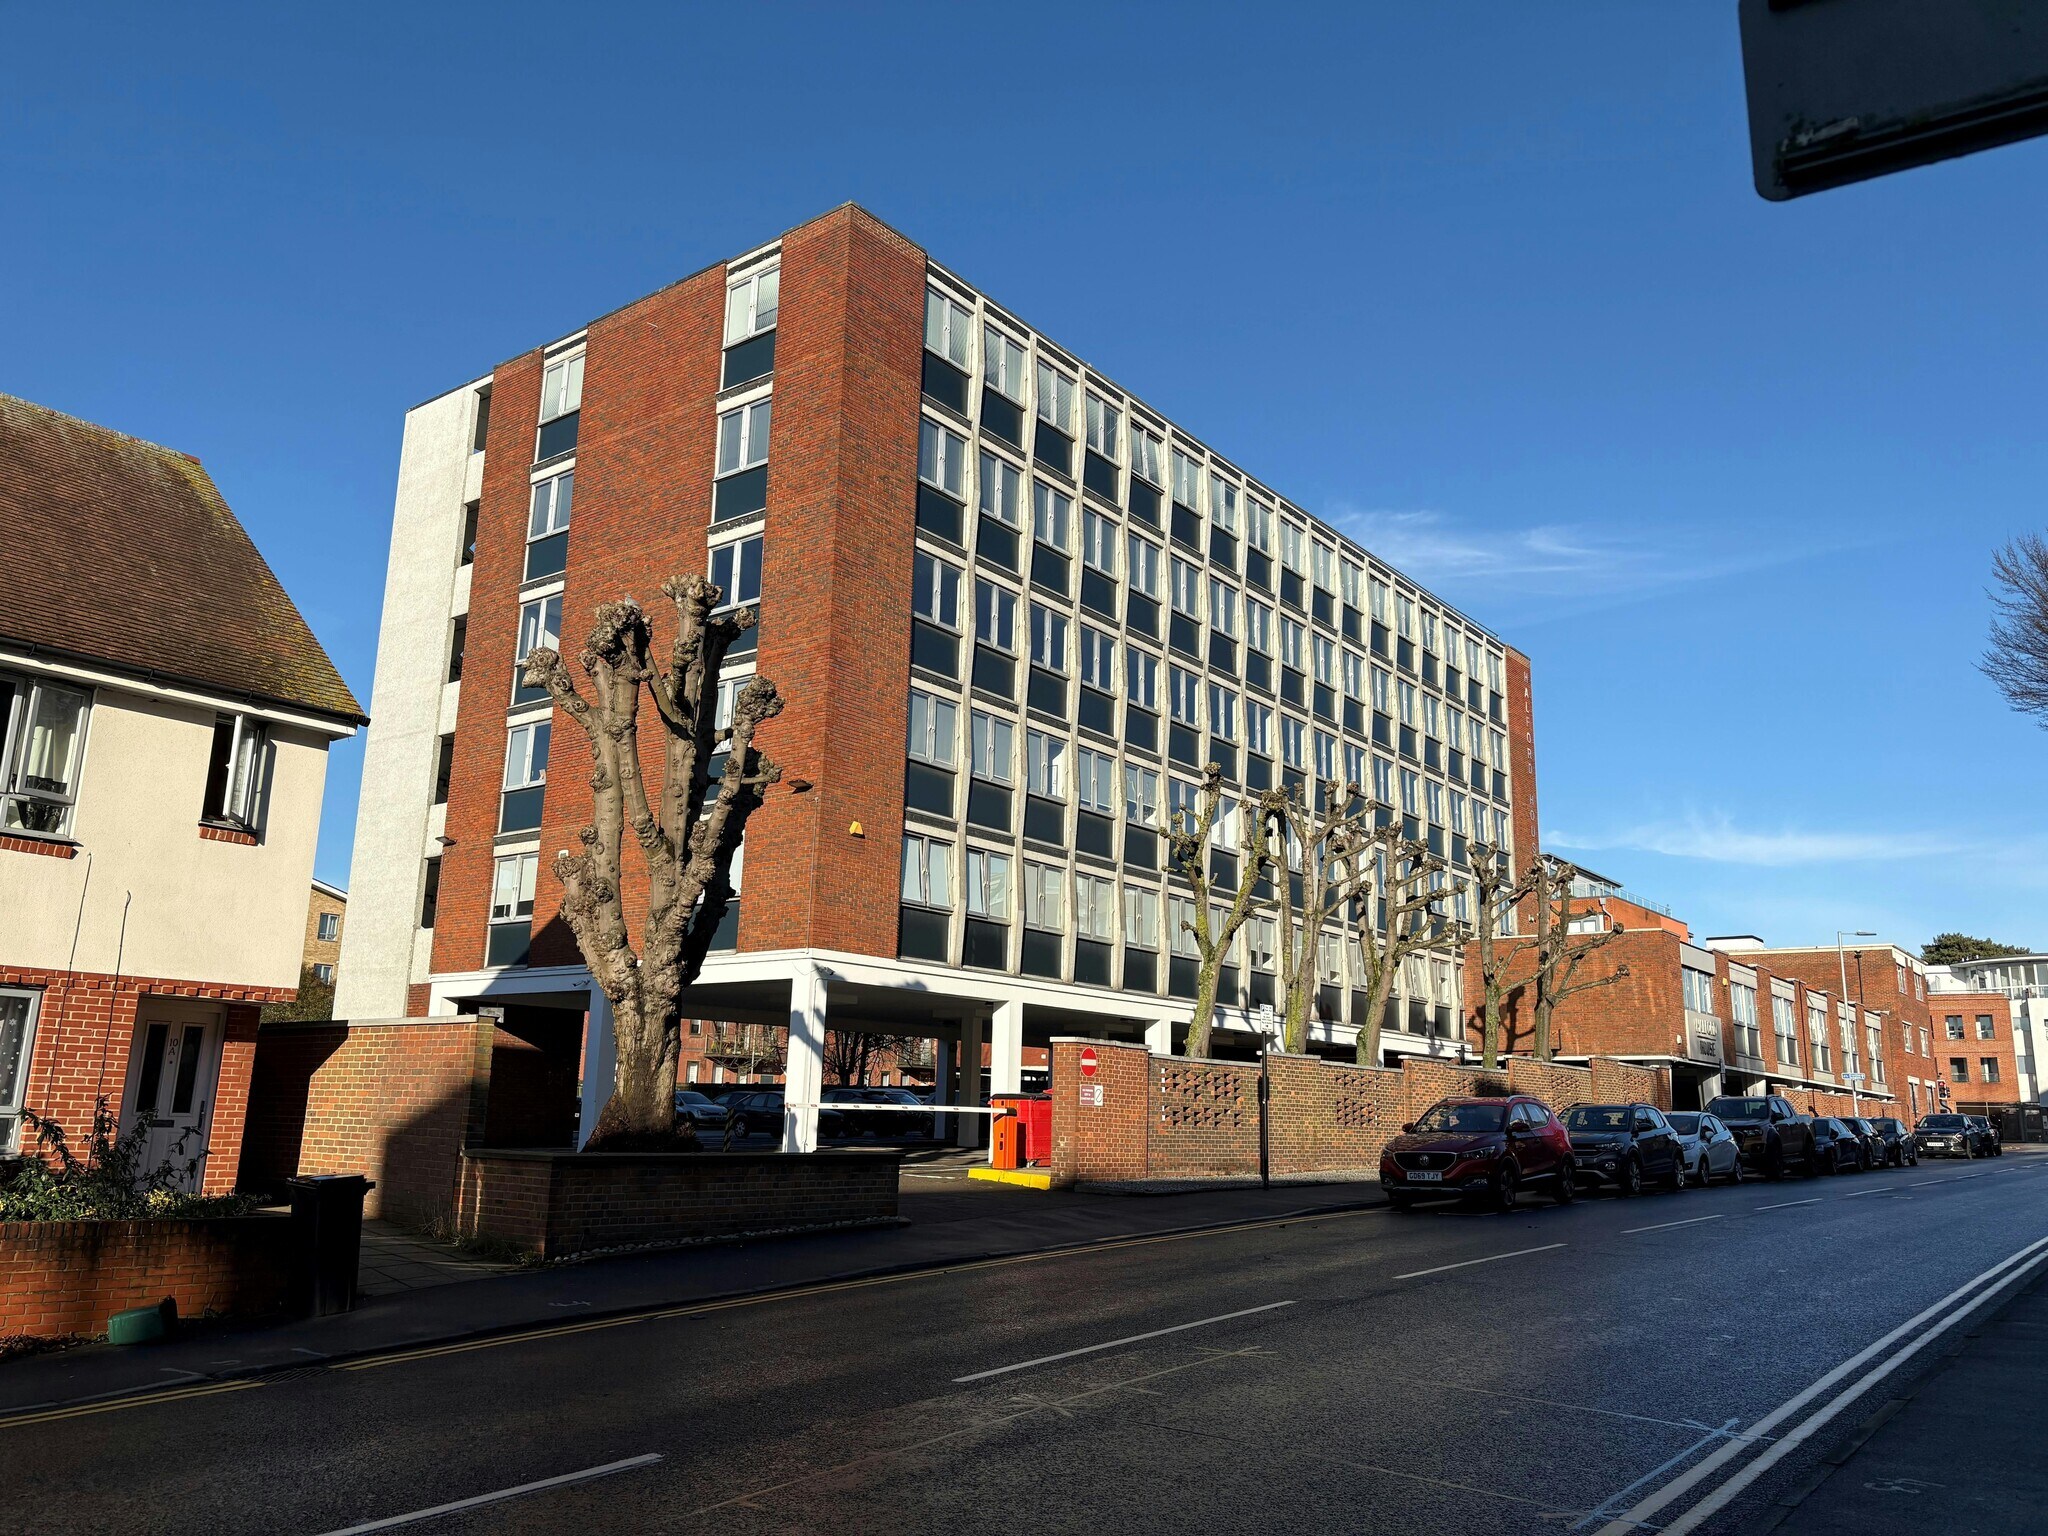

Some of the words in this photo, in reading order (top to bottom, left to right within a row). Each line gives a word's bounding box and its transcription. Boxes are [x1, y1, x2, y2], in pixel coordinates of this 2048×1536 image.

[170, 1038, 179, 1047] 10
[168, 1047, 175, 1055] A
[1427, 1172, 1439, 1180] TJY
